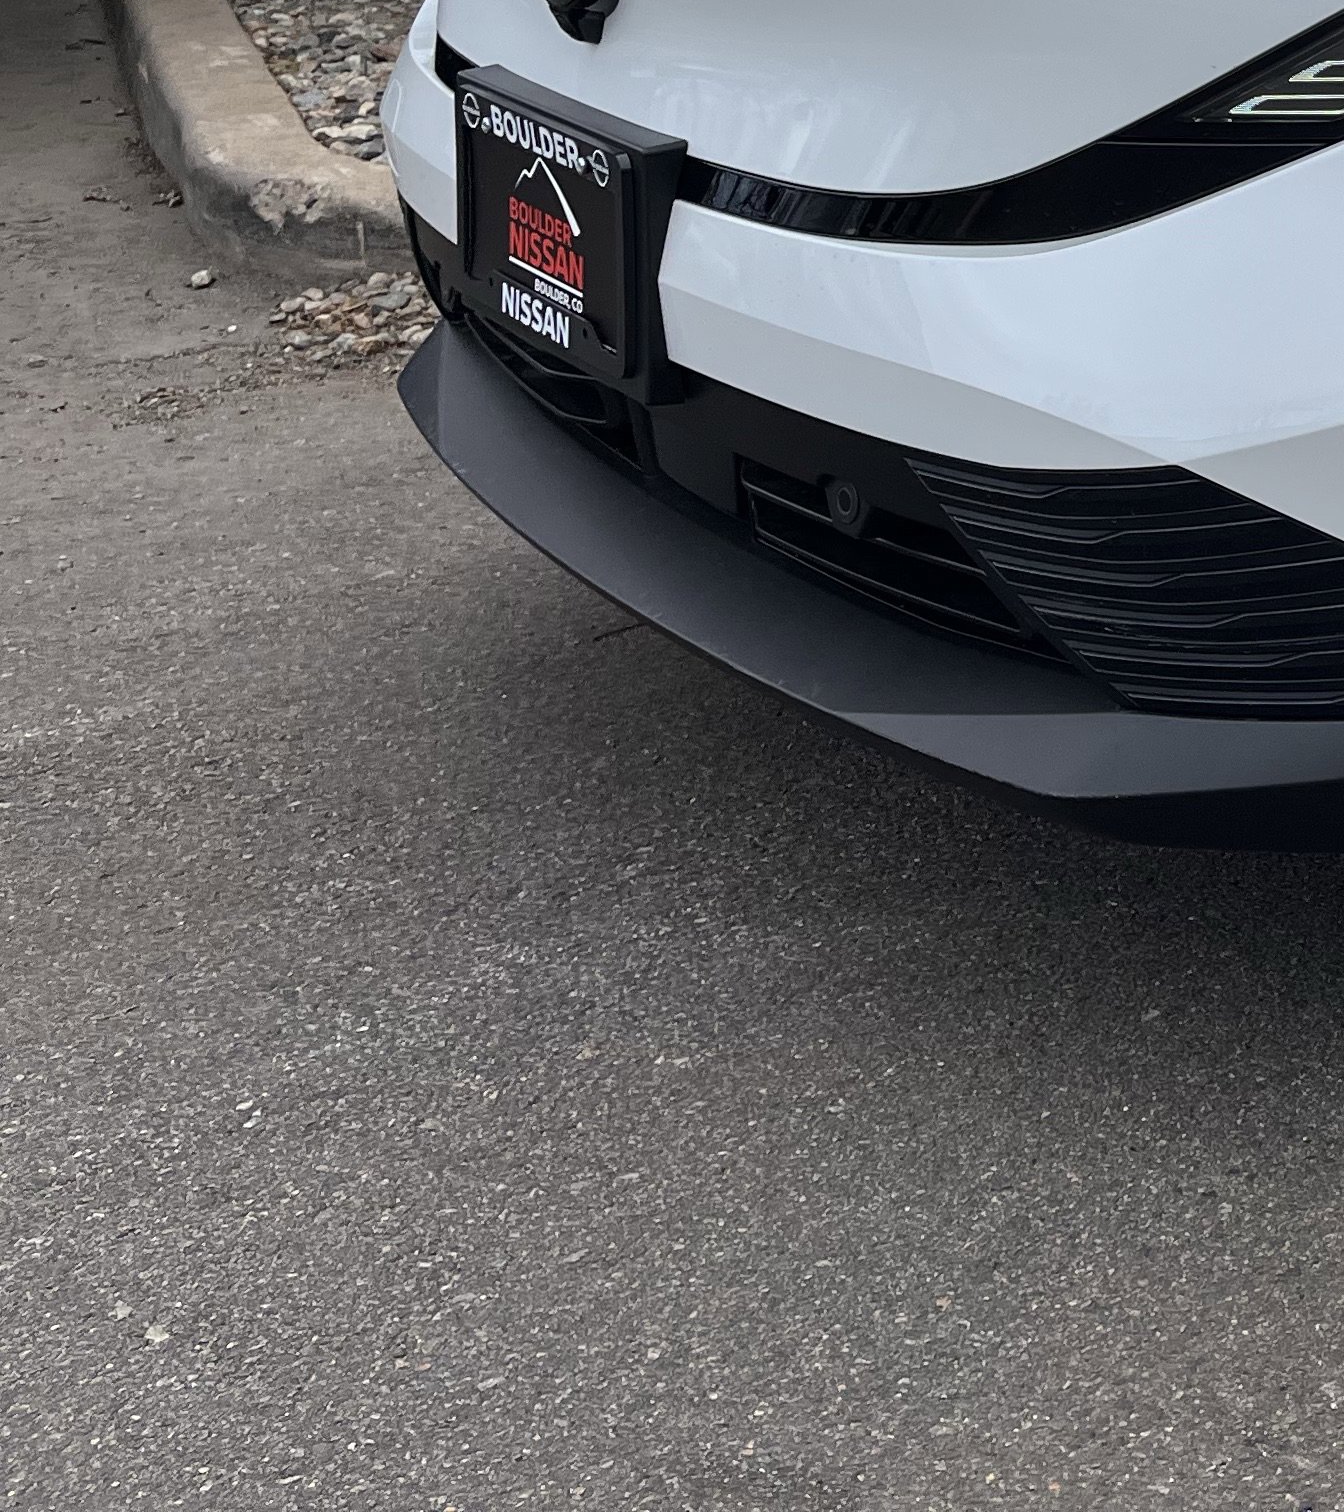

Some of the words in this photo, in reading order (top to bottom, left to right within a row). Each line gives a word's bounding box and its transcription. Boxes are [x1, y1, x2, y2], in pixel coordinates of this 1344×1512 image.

[489, 104, 580, 170] BOULDER
[508, 196, 573, 245] BOULDER
[508, 227, 585, 291] NISSAN
[501, 282, 571, 349] NISSAN
[571, 299, 584, 315] CO
